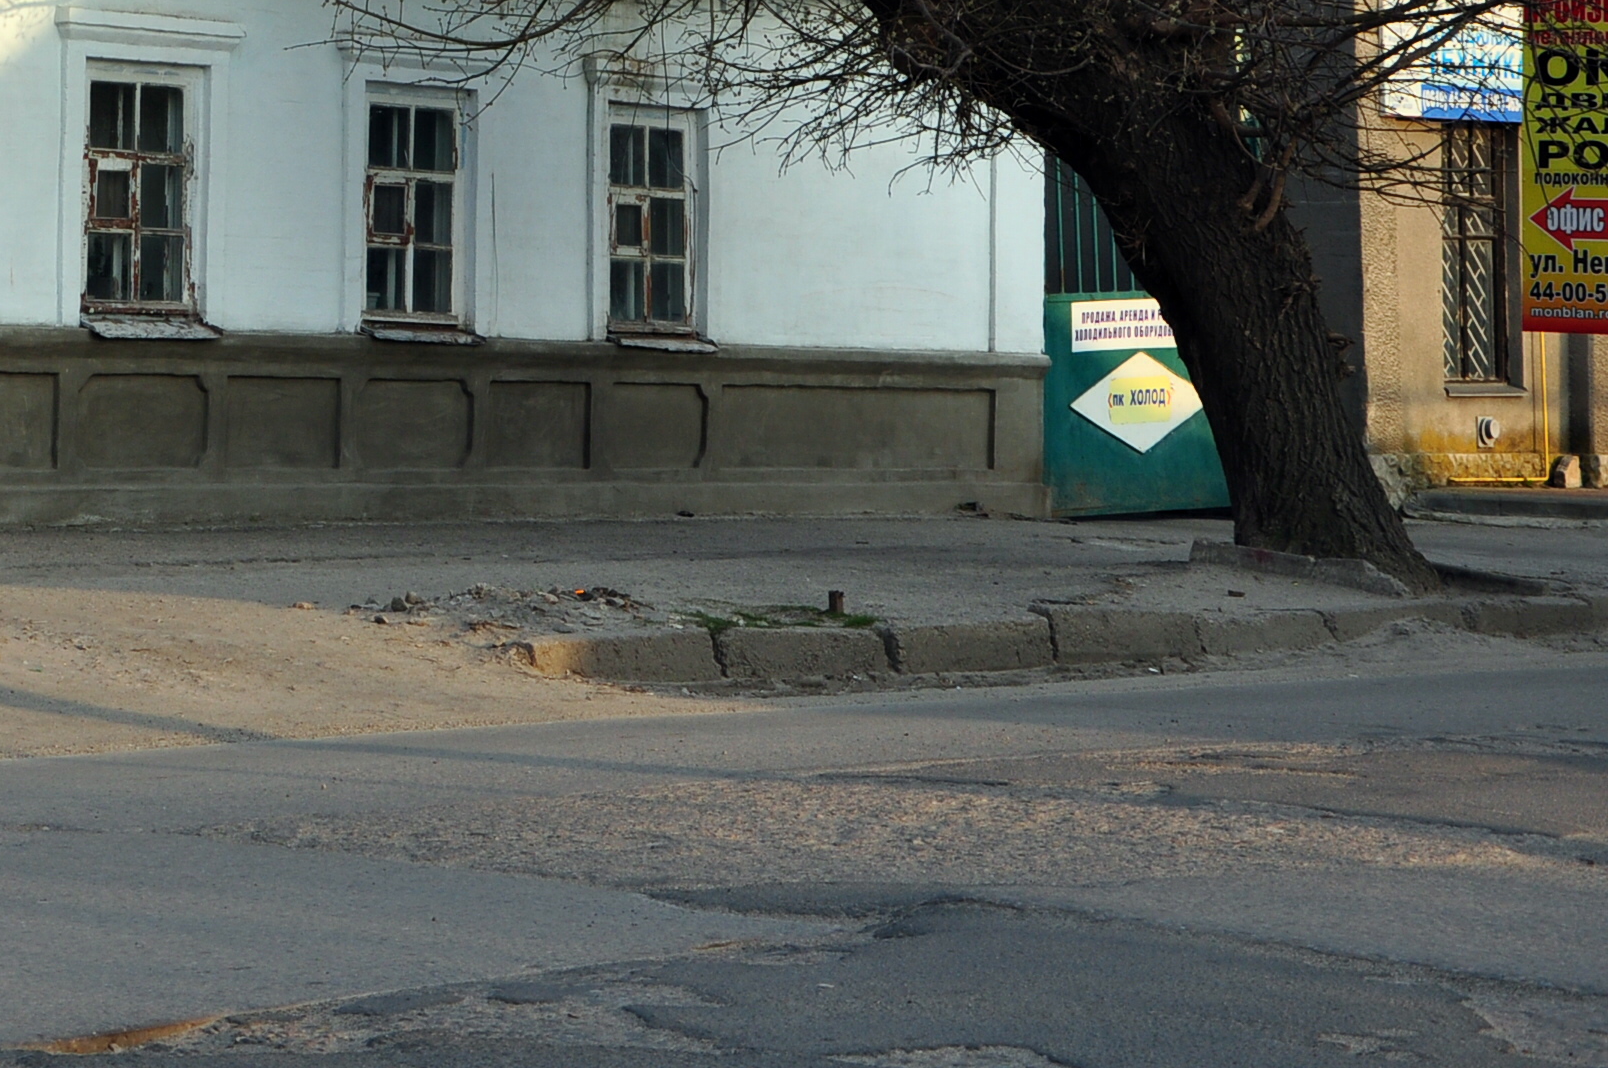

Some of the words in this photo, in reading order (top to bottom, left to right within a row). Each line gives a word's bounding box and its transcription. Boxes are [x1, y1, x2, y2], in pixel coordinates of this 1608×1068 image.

[1535, 92, 1608, 111] ДВ
[1535, 116, 1608, 135] ЖА
[1547, 203, 1605, 235] офис
[1529, 254, 1565, 279] ул.
[1573, 249, 1608, 274] Не
[1529, 281, 1607, 303] 44-00-5
[1119, 309, 1148, 322] АРЕНДА
[1074, 326, 1132, 343] ХОЛОДИЛЬНОГО
[1129, 388, 1167, 408] ХОЛОД
